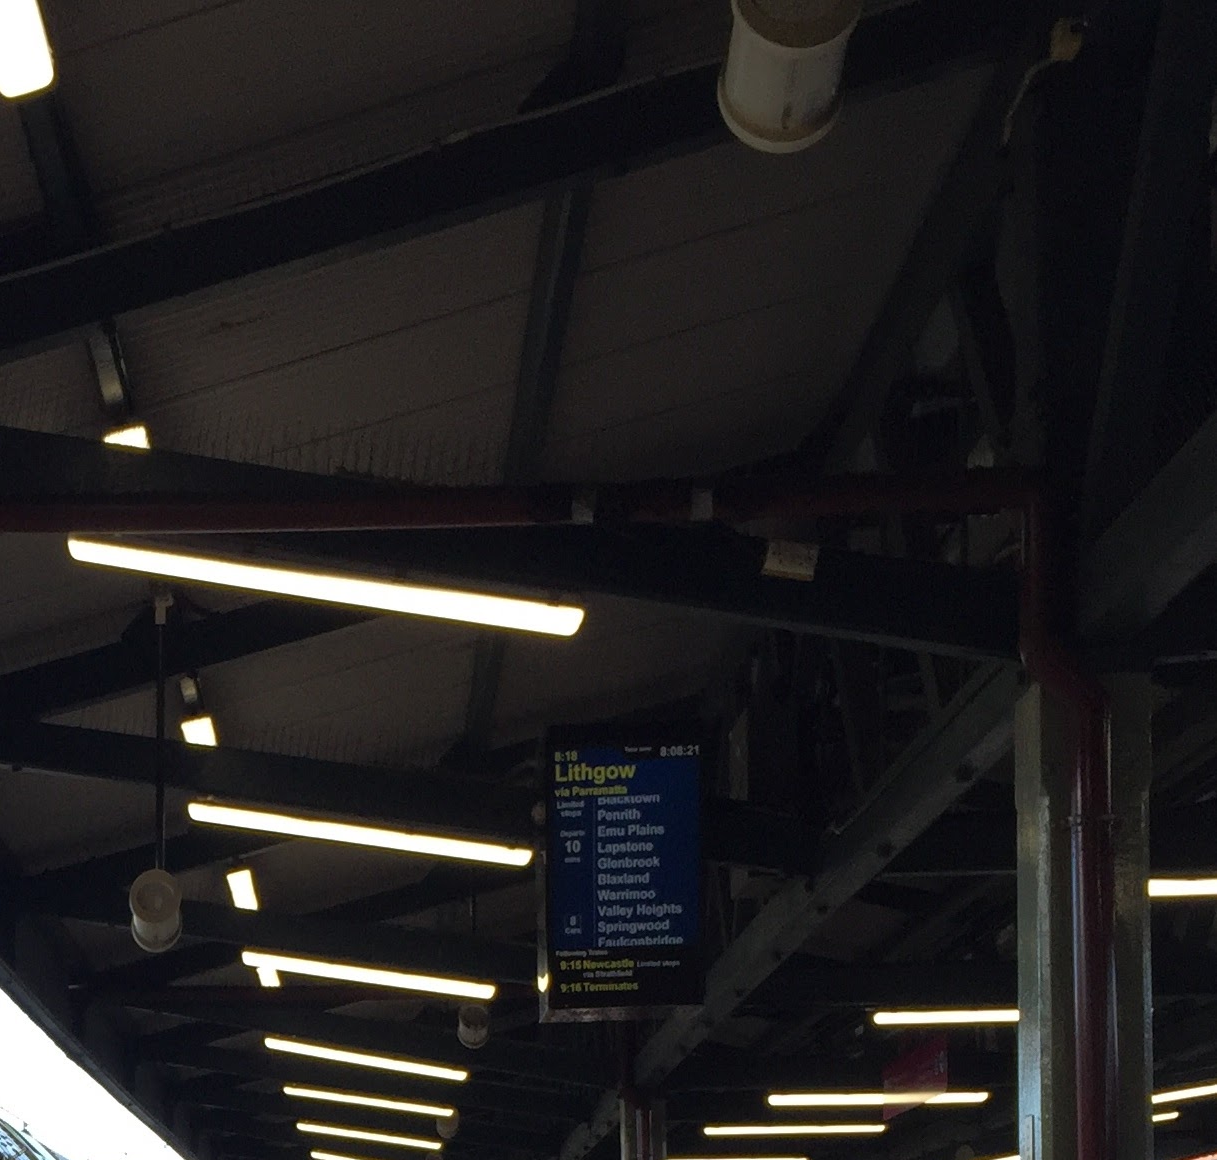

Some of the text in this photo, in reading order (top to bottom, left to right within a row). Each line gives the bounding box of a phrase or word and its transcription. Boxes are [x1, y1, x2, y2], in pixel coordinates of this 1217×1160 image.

[660, 745, 700, 757] 8:08:21
[554, 763, 636, 784] Lithgow
[554, 785, 628, 797] via Parramatta
[597, 808, 641, 821] Penrith
[597, 824, 665, 838] Emu Plains
[564, 840, 581, 853] 10
[597, 841, 654, 855] Lapstone
[597, 856, 660, 870] Glenbrook
[597, 872, 650, 885] Blaxland
[597, 889, 656, 901] Warrimoo
[597, 903, 683, 918] Valley Heights
[569, 915, 577, 926] 8
[597, 919, 670, 935] Springwood
[583, 958, 635, 969] Newcastle
